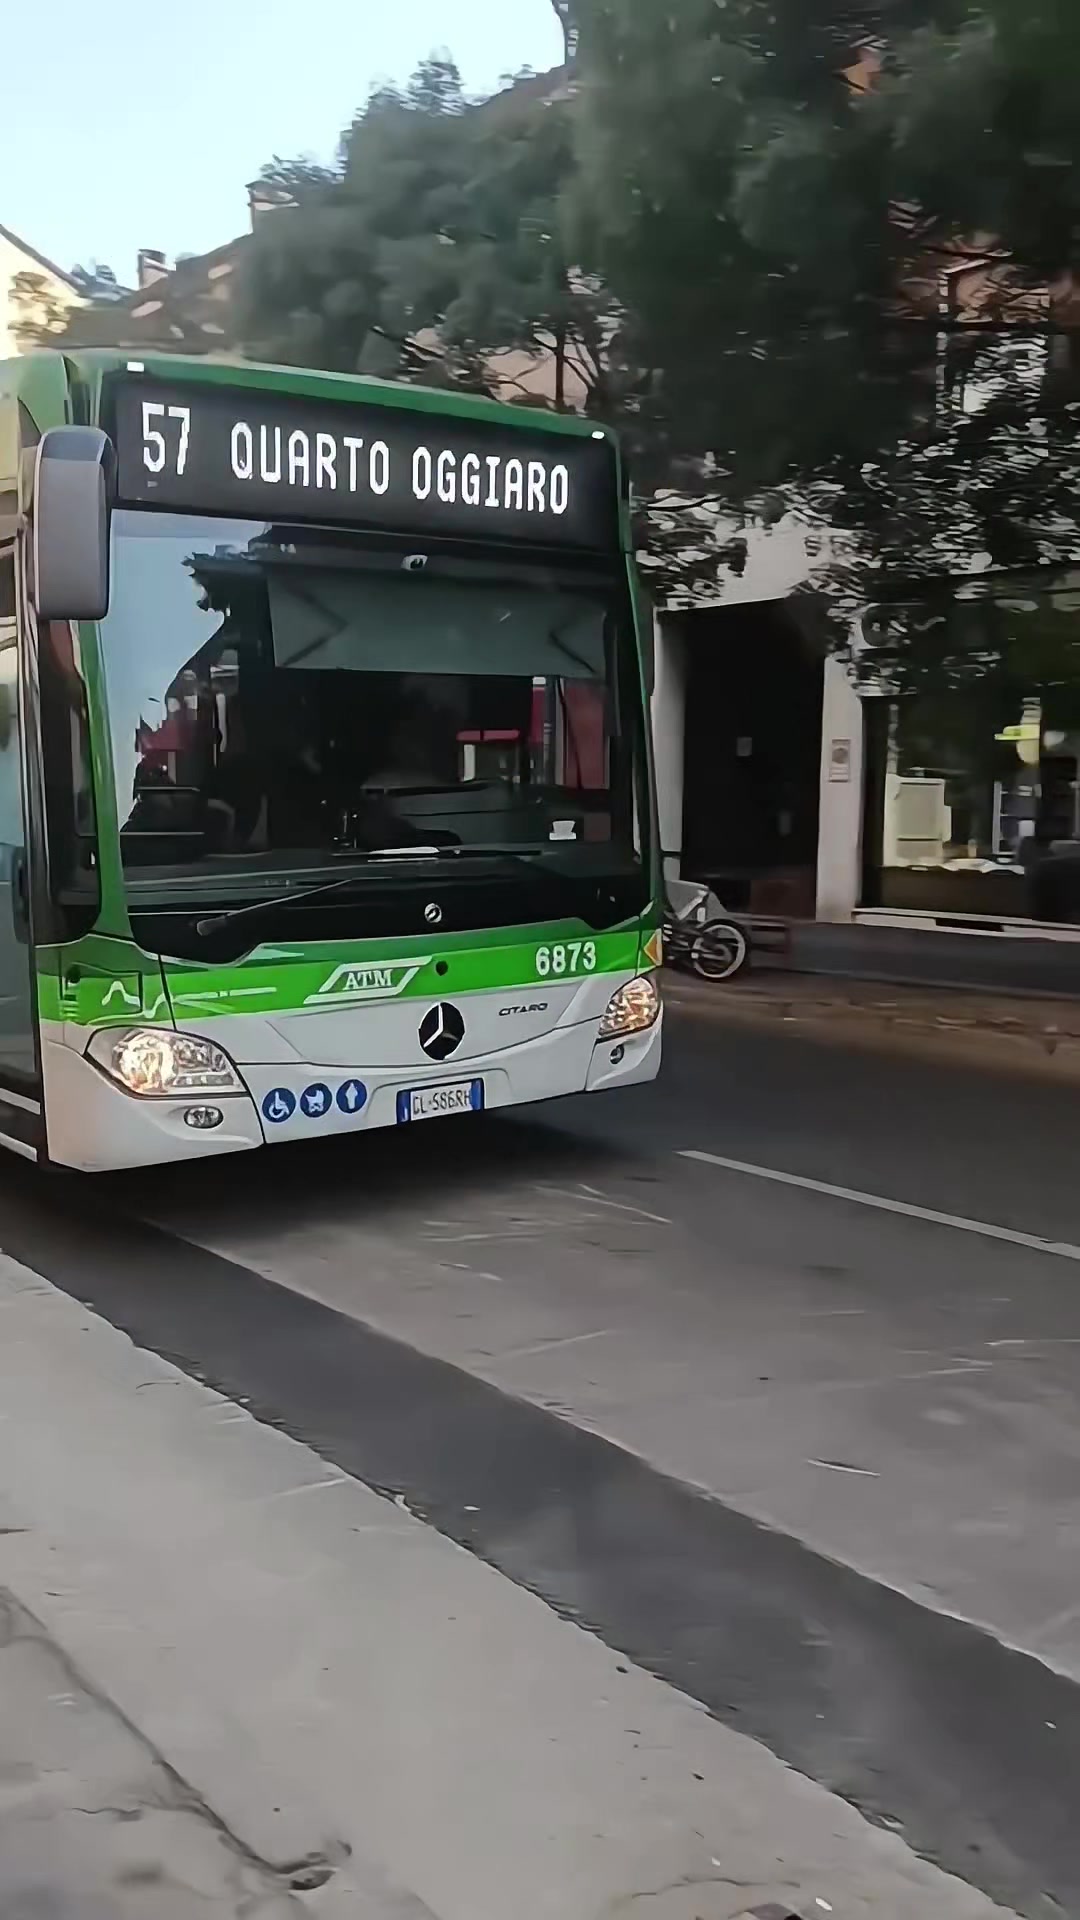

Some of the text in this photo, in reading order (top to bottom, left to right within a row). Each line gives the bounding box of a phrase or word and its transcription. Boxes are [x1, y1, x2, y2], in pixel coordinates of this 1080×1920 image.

[142, 402, 569, 514] 57 QUARTO OGGIARO
[535, 941, 596, 975] 6873
[342, 968, 393, 991] ATM
[498, 1002, 548, 1016] CITARO
